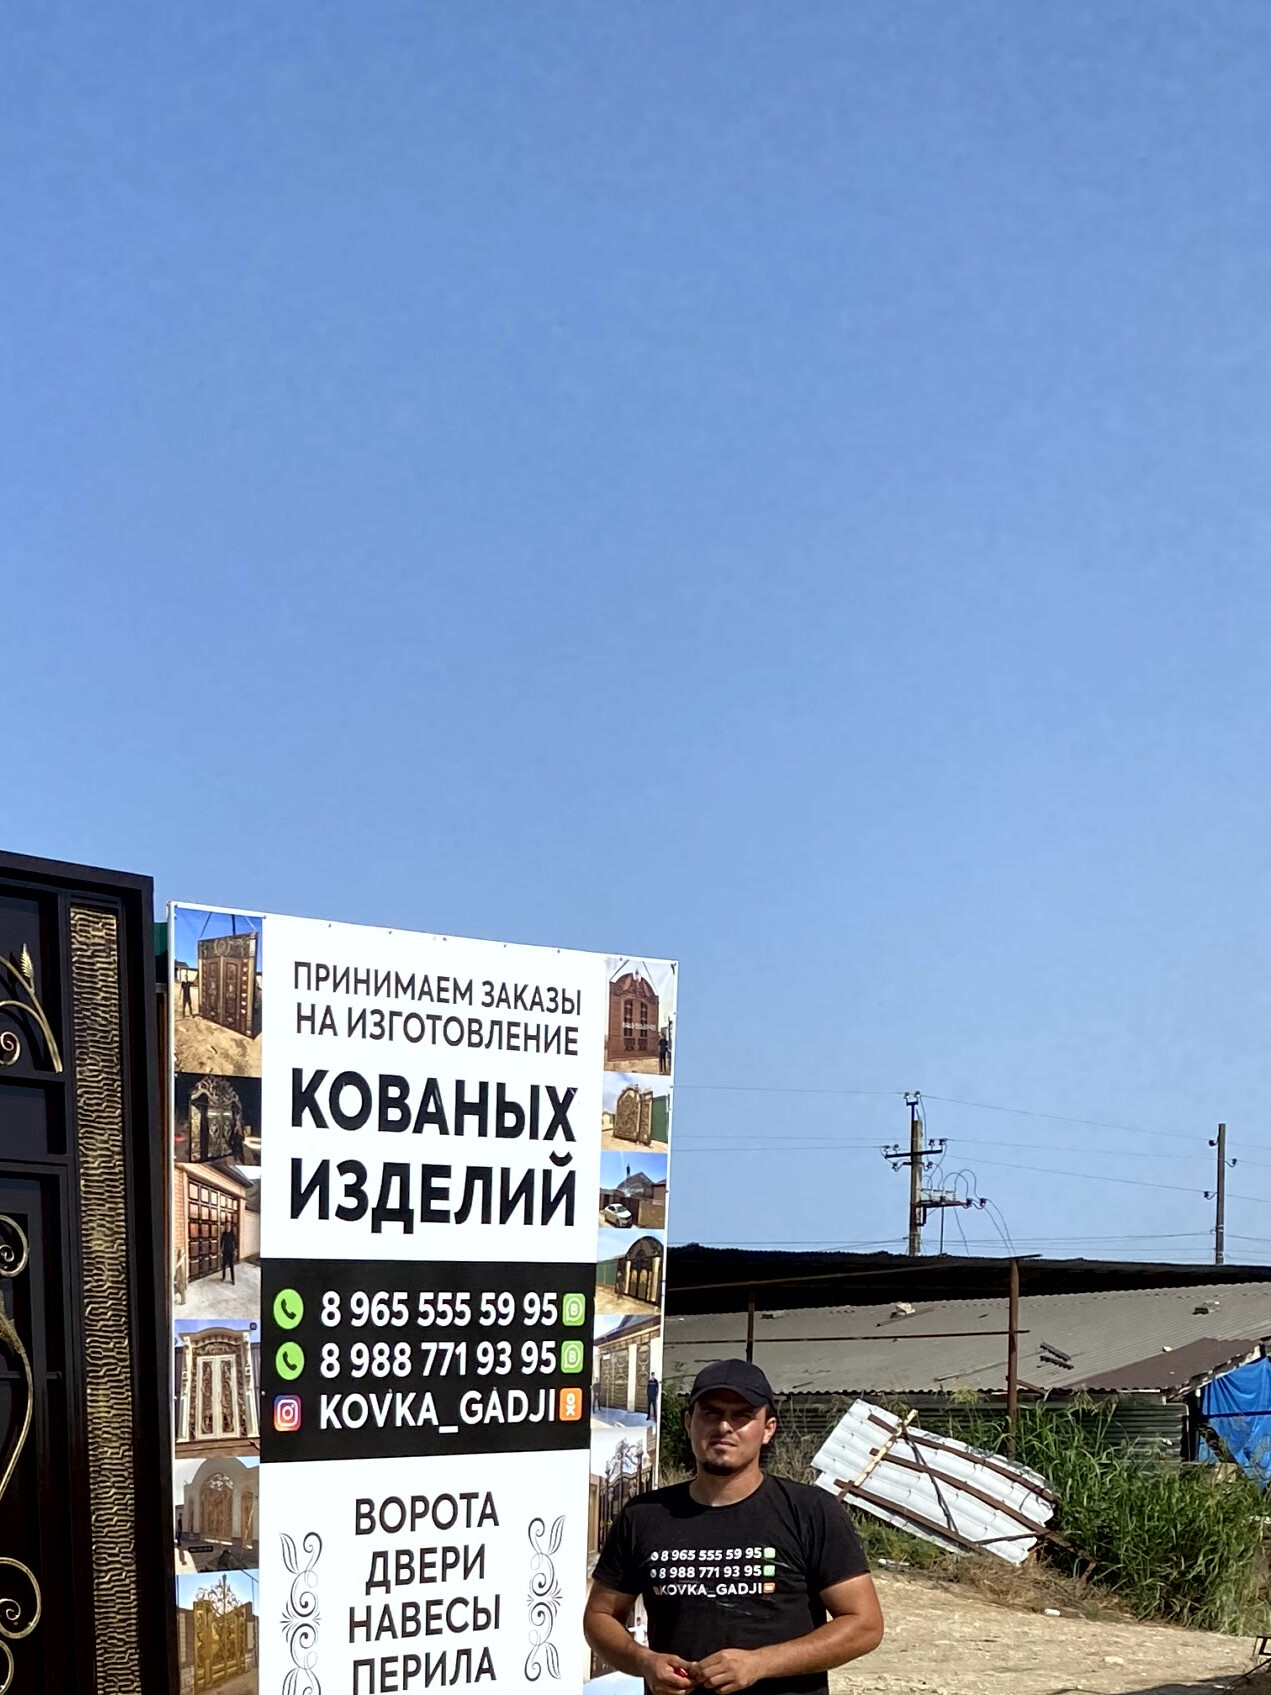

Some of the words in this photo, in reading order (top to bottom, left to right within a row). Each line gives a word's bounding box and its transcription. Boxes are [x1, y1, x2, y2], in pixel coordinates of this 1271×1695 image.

[294, 961, 473, 1005] ПРИНИМАЕМ
[482, 981, 580, 1015] ЗАКАЗЫ
[297, 1003, 337, 1036] НА
[347, 1007, 579, 1055] ИЗГОТОВЛЕНИЕ
[292, 1068, 577, 1142] КОВАНЫХ
[291, 1151, 575, 1234] ИЗДЕЛИЙ
[321, 1291, 341, 1327] 8
[351, 1291, 408, 1326] 965
[417, 1292, 471, 1326] 555
[479, 1292, 515, 1326] 59
[524, 1292, 557, 1325] 95
[321, 1343, 340, 1378] 8
[351, 1342, 411, 1377] 988
[421, 1342, 466, 1376] 771
[477, 1341, 511, 1375] 93
[521, 1341, 556, 1374] 95
[321, 1388, 555, 1433] KOVKA_GADJI
[356, 1492, 499, 1535] ВОРОТА
[366, 1544, 485, 1596] ДВЕРИ
[660, 1568, 666, 1578] 8
[670, 1567, 695, 1578] 988
[699, 1567, 719, 1578] 771
[724, 1566, 740, 1577] 93
[744, 1565, 761, 1576] 95
[661, 1551, 668, 1561] 8
[672, 1550, 695, 1560] 965
[699, 1550, 722, 1560] 555
[726, 1549, 742, 1559] 59
[746, 1547, 761, 1558] 95
[659, 1583, 762, 1597] KOVKA_GADJI
[349, 1594, 501, 1643] НАВЕСЫ
